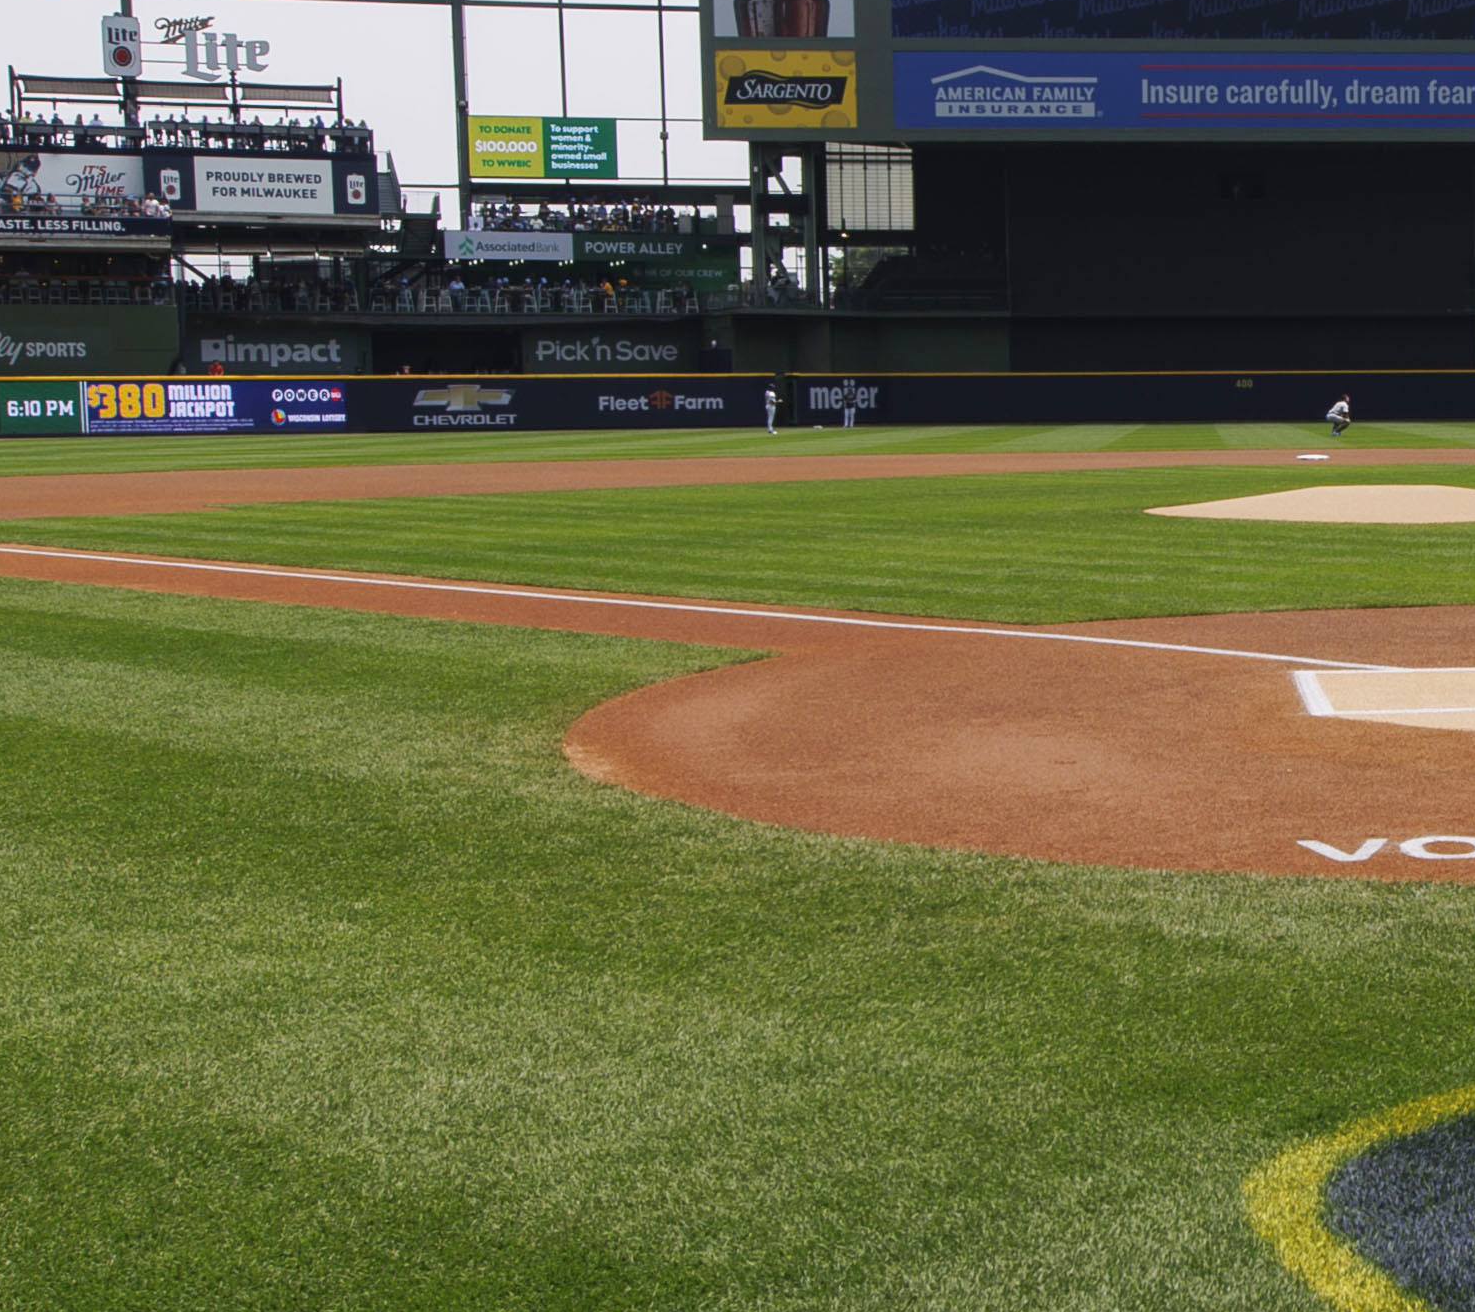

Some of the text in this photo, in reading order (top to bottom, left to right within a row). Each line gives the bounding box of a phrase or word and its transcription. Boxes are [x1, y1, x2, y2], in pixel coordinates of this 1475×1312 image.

[182, 29, 271, 82] Lite
[736, 77, 833, 101] SARGENTO
[935, 86, 1095, 102] AMERICAN FAMILY
[1141, 78, 1218, 105] Insure
[1226, 77, 1338, 110] carefully,
[1345, 79, 1421, 106] dream
[946, 103, 1084, 116] INSURANCE
[493, 125, 532, 135] DONATE
[562, 124, 599, 135] support
[475, 140, 537, 154] $100,000
[550, 152, 608, 161] owned small
[550, 161, 599, 170] businesses
[65, 172, 126, 195] Miller
[205, 171, 323, 185] PROUDLY BREWED
[212, 187, 318, 200] FOR MILWAUKEE
[37, 220, 69, 231] LESS
[72, 220, 126, 233] FILLING.
[585, 241, 683, 255] POWER ALLEY
[25, 342, 87, 358] SPORTS
[227, 336, 342, 368] impact
[615, 340, 679, 362] Save
[6, 400, 75, 418] 6:10 PM
[87, 382, 233, 420] $380 MILLION
[168, 400, 236, 418] JACKPOT
[598, 394, 724, 411] Fleet Farm
[413, 414, 518, 426] CHEVROLET
